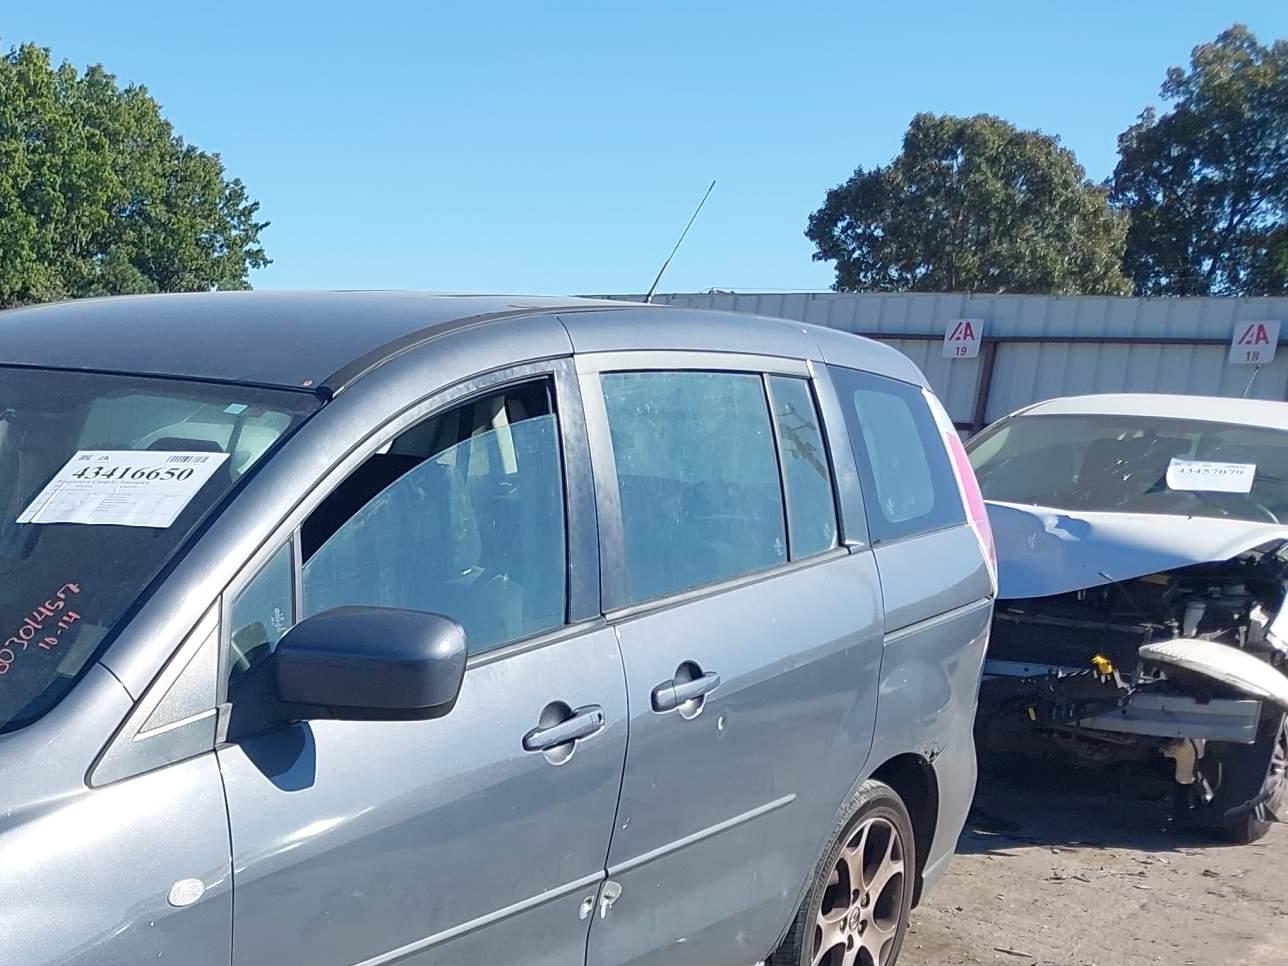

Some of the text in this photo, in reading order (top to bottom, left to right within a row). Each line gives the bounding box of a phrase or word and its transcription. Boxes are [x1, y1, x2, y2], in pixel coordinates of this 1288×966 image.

[955, 346, 968, 356] 19
[1246, 351, 1260, 361] 18
[72, 466, 194, 481] 43416650
